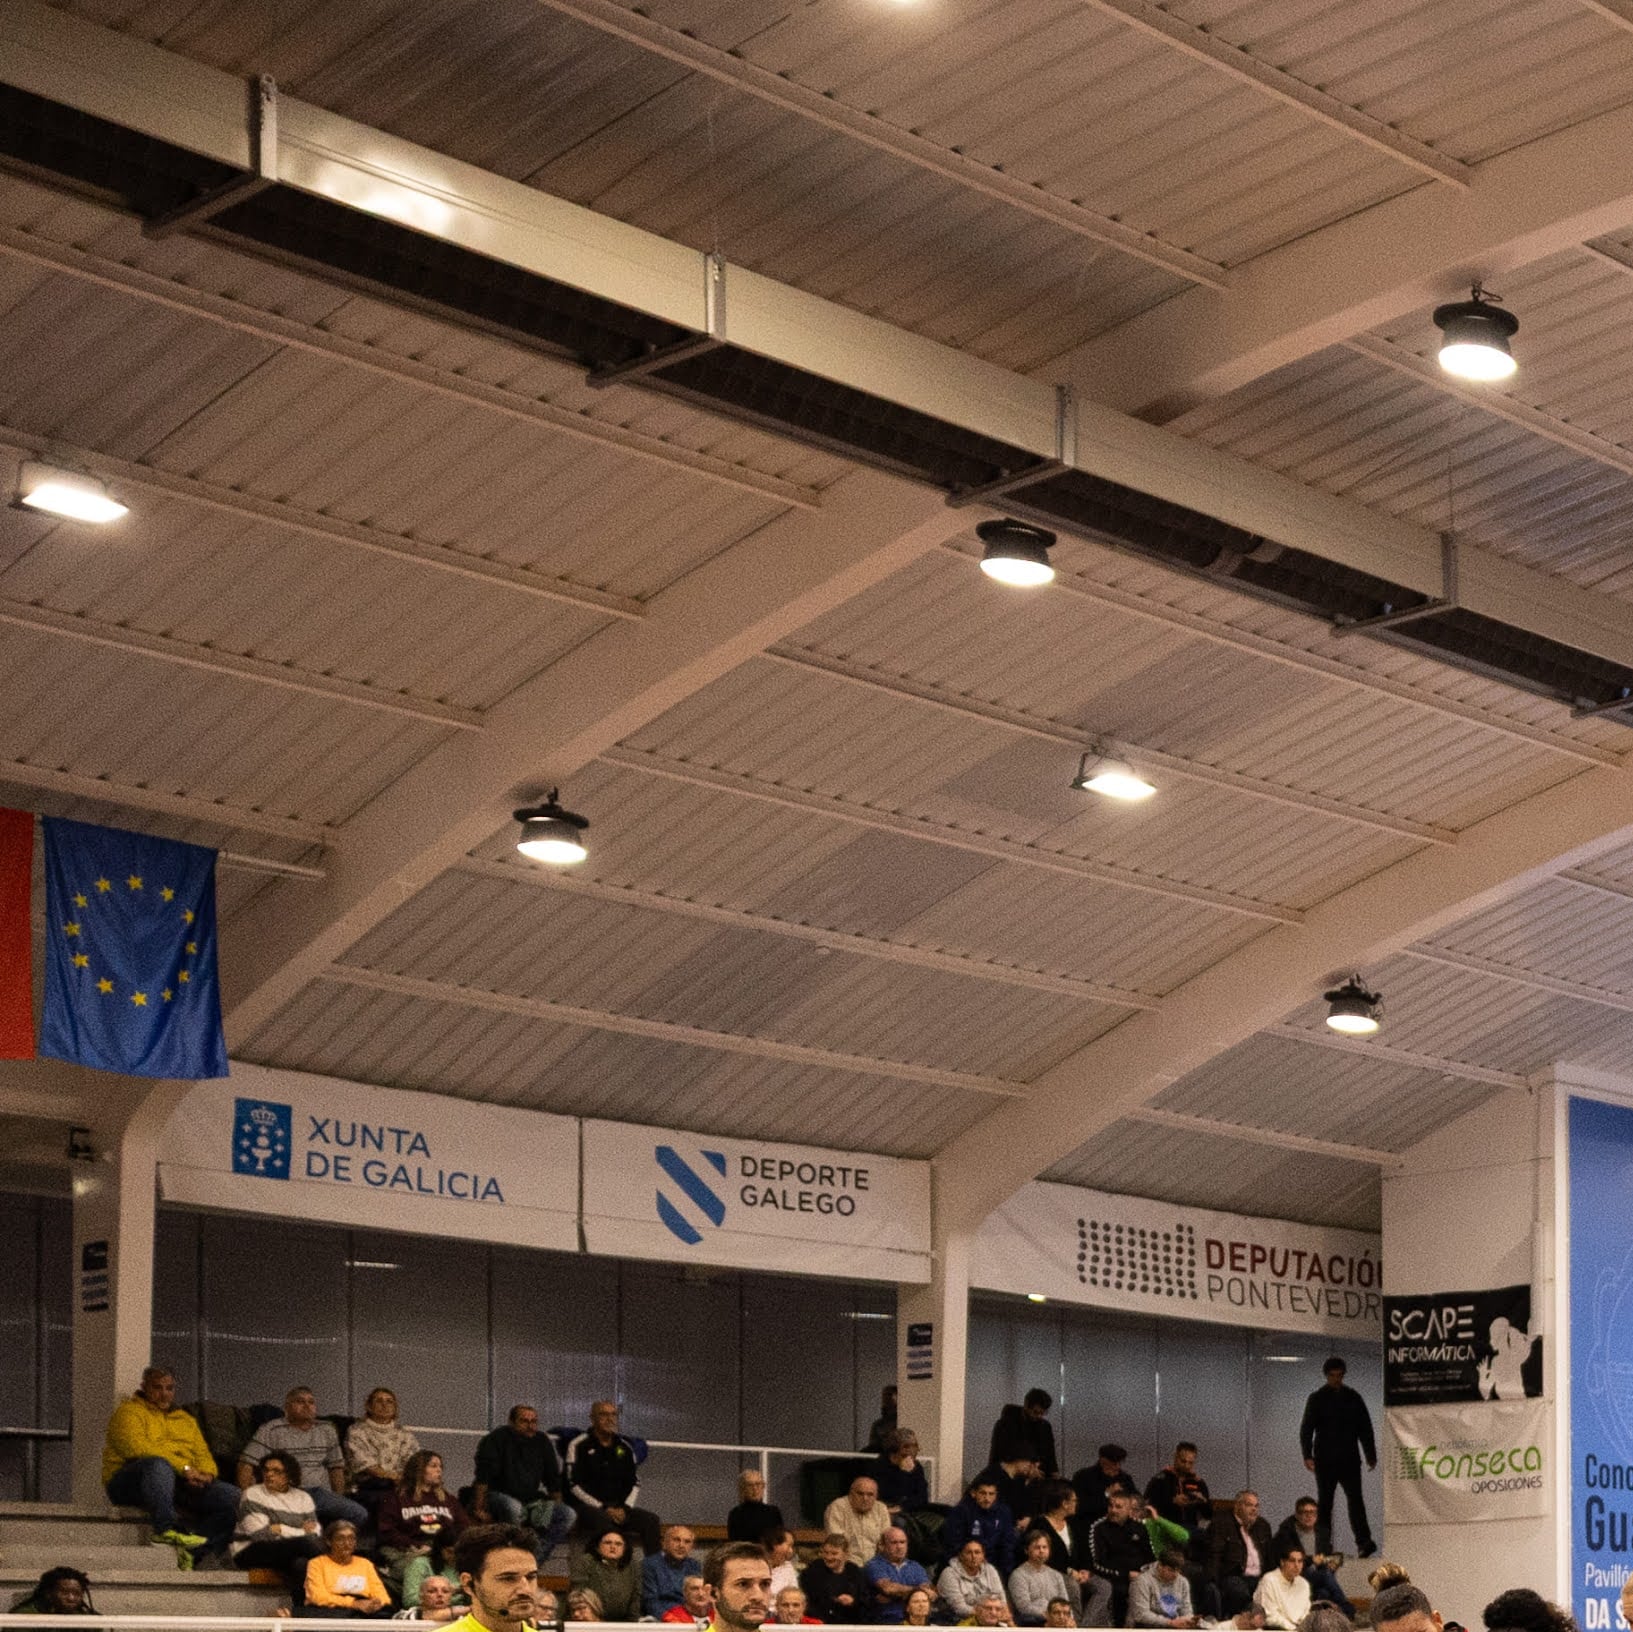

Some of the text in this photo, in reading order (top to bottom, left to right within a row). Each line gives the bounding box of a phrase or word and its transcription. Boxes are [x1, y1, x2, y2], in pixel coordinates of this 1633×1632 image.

[308, 1115, 431, 1159] XUNTA
[306, 1151, 505, 1203] DE GALICIA
[740, 1156, 870, 1191] DEPORTE
[739, 1184, 856, 1217] GALEGO
[1207, 1274, 1381, 1322] PONTEVEDR
[1388, 1304, 1475, 1341] SCAPE
[1388, 1342, 1477, 1364] INFORMÁTICA
[1471, 1475, 1544, 1494] OPOSICIONES
[1585, 1597, 1611, 1630] DA
